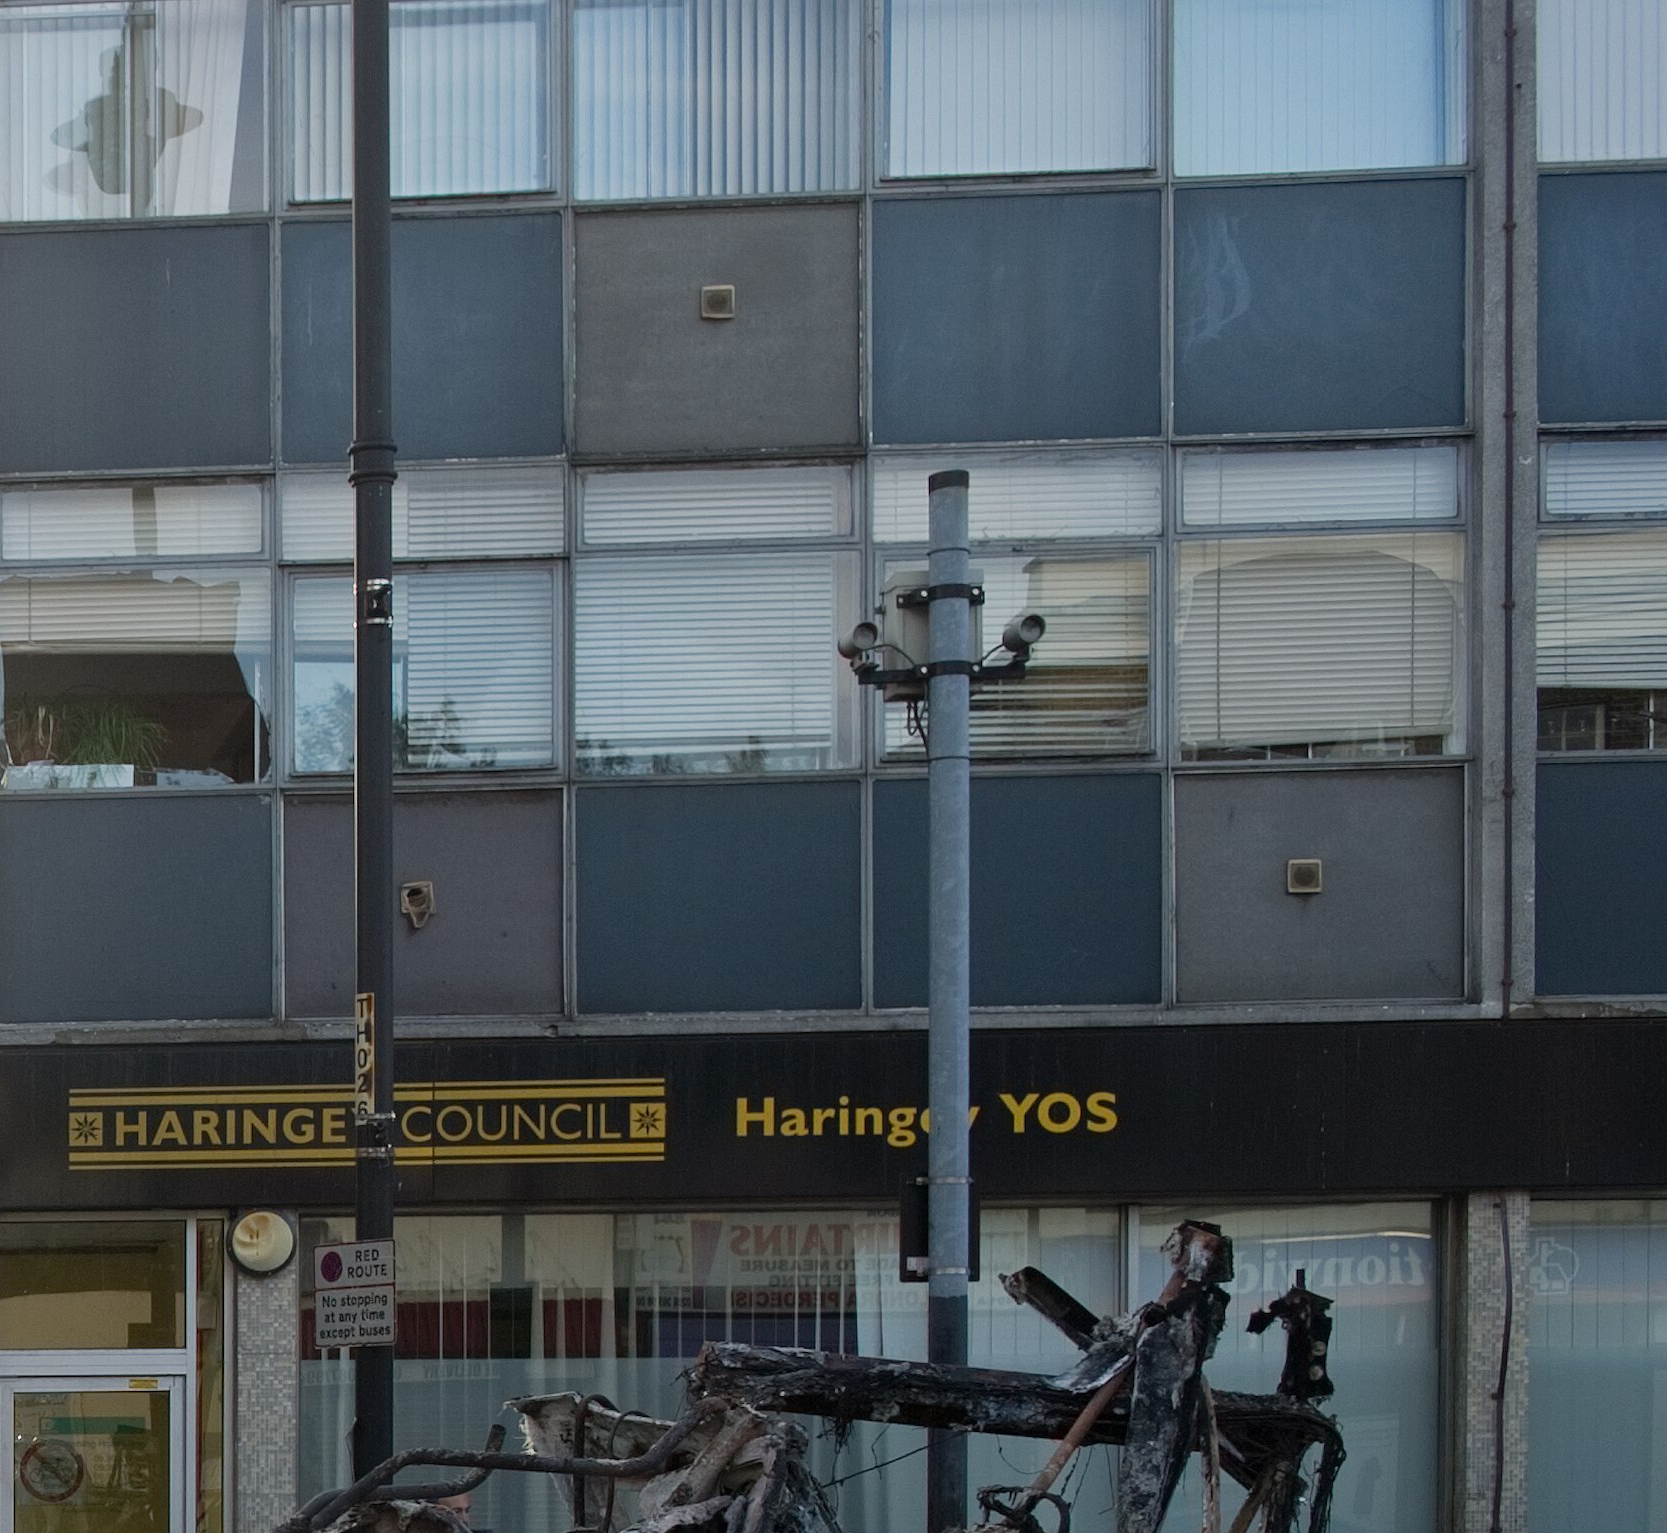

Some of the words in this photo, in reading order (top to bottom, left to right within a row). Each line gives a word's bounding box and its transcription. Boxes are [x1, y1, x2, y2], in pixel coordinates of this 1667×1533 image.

[998, 1091, 1119, 1134] YOS
[116, 1109, 358, 1146] HARINGE
[402, 1102, 622, 1143] COUNCIL
[354, 1249, 380, 1262] RED
[347, 1263, 388, 1279] ROUTE
[322, 1295, 337, 1308] No
[340, 1292, 388, 1308] stopping
[324, 1312, 336, 1323] at
[339, 1312, 358, 1324] any
[362, 1309, 386, 1321] time
[320, 1328, 356, 1340] except
[359, 1324, 391, 1337] buses
